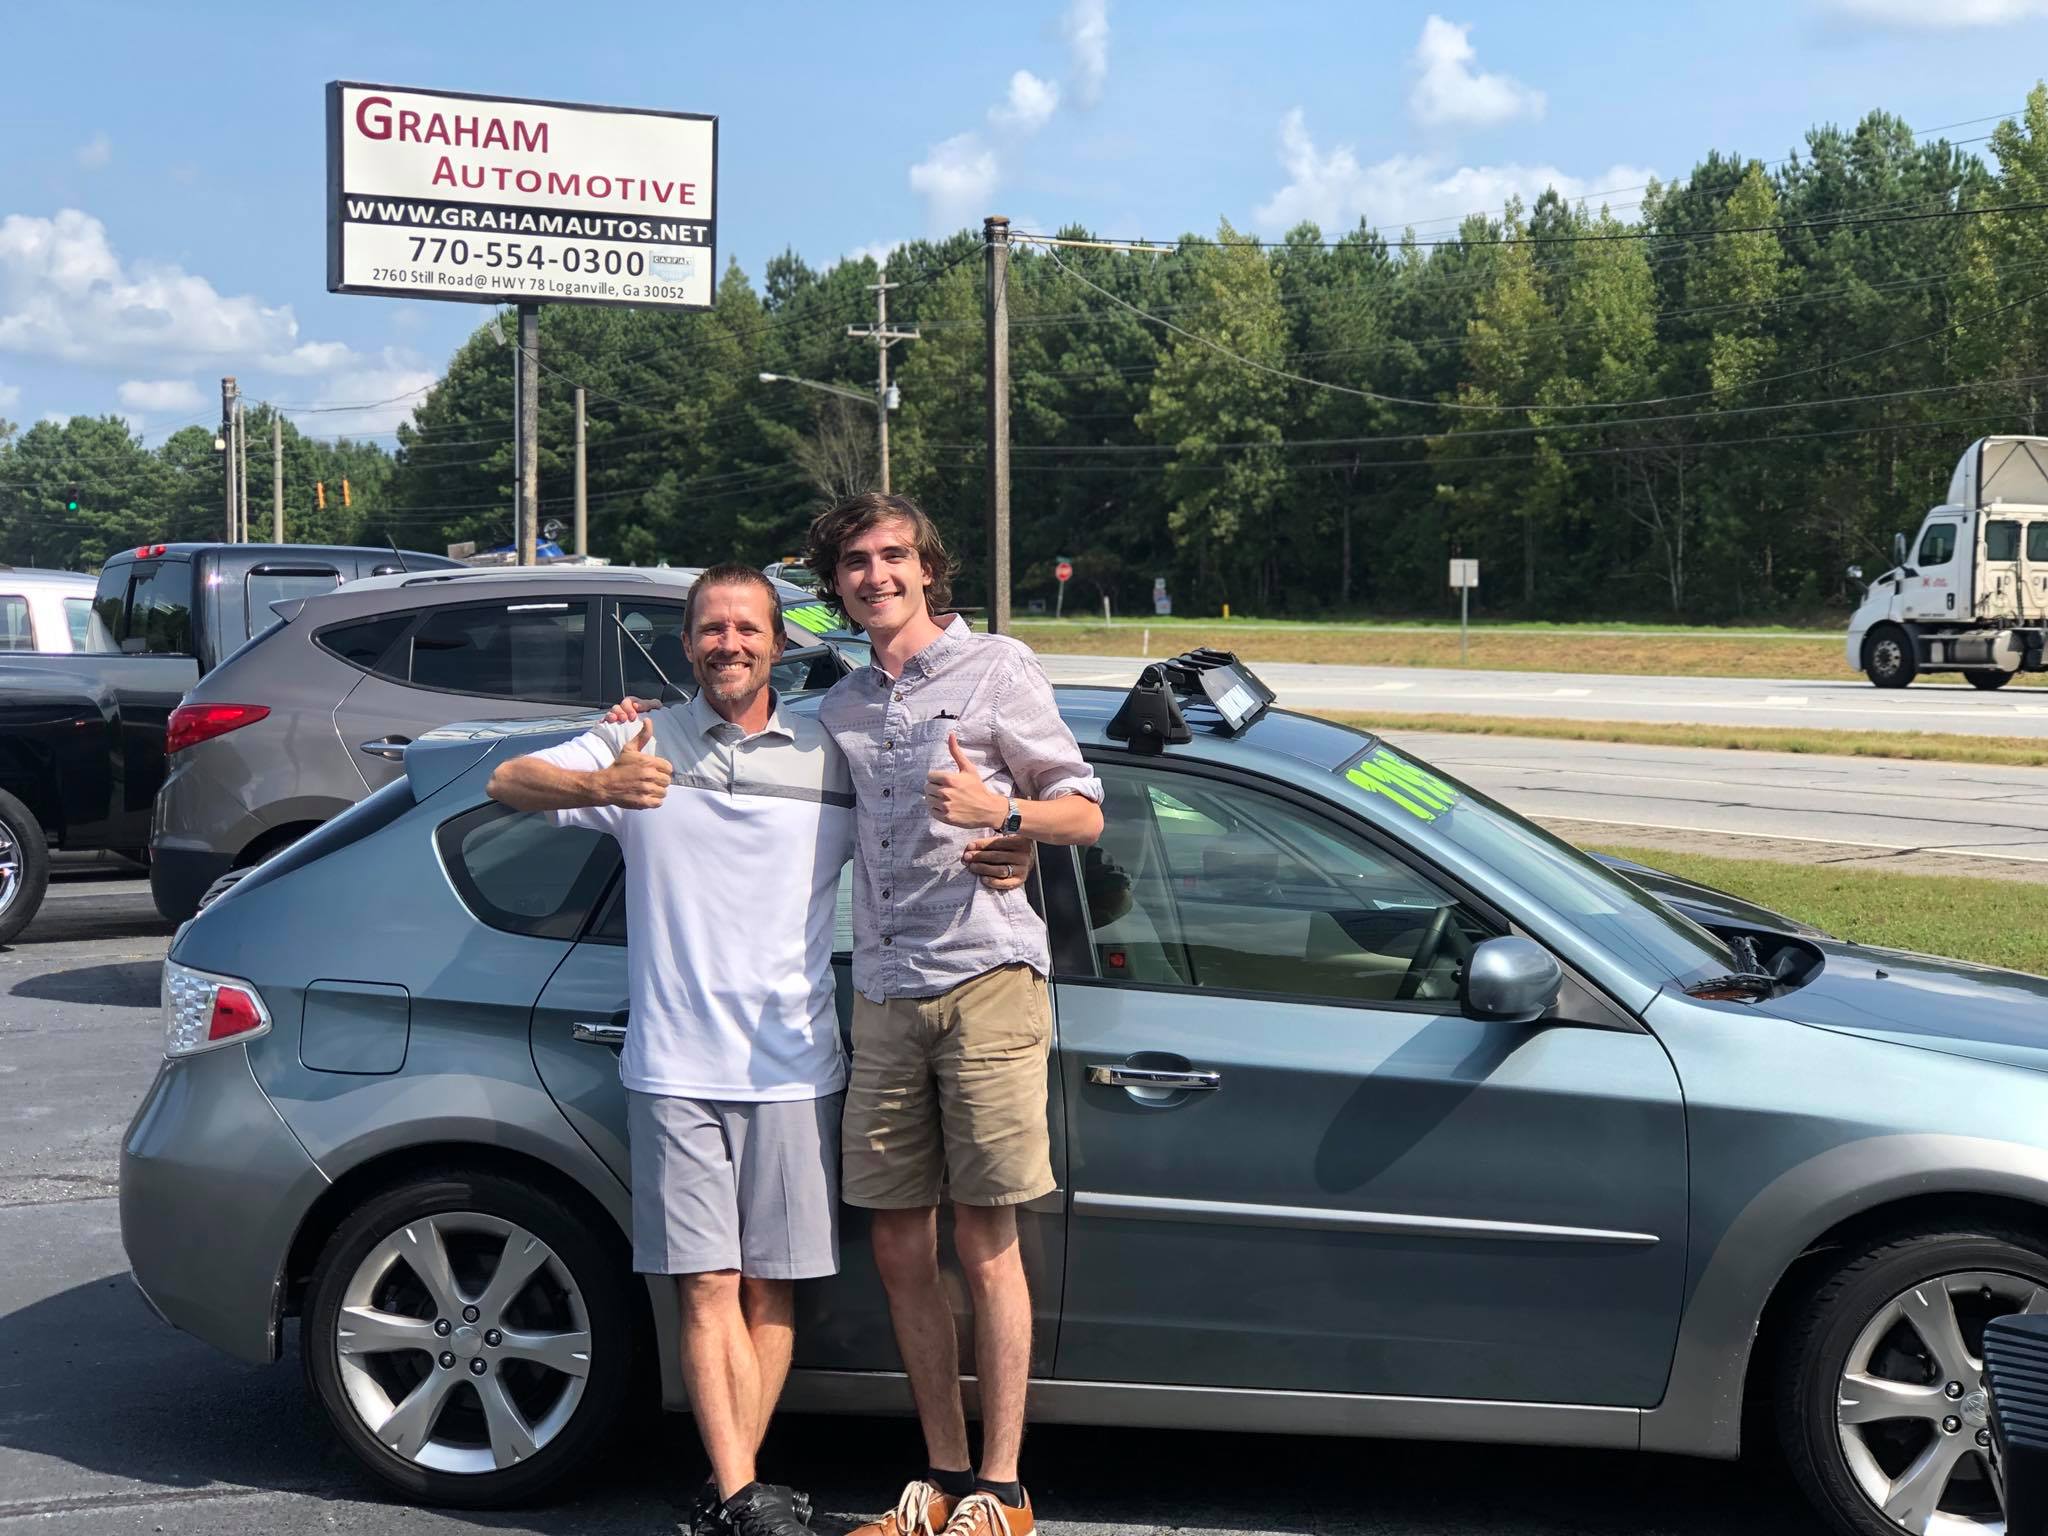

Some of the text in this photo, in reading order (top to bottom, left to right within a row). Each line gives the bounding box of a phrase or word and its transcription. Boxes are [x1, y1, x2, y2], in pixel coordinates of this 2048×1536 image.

[356, 96, 549, 154] GRAHAM
[432, 156, 696, 206] AUTOMOTIVE
[347, 200, 708, 243] WWW.GRAHAMAUTOS.NET
[409, 236, 644, 276] 770-554-0300
[373, 268, 684, 299] 2760 Still Road@ HWY 78 Loganville, Ga 30052
